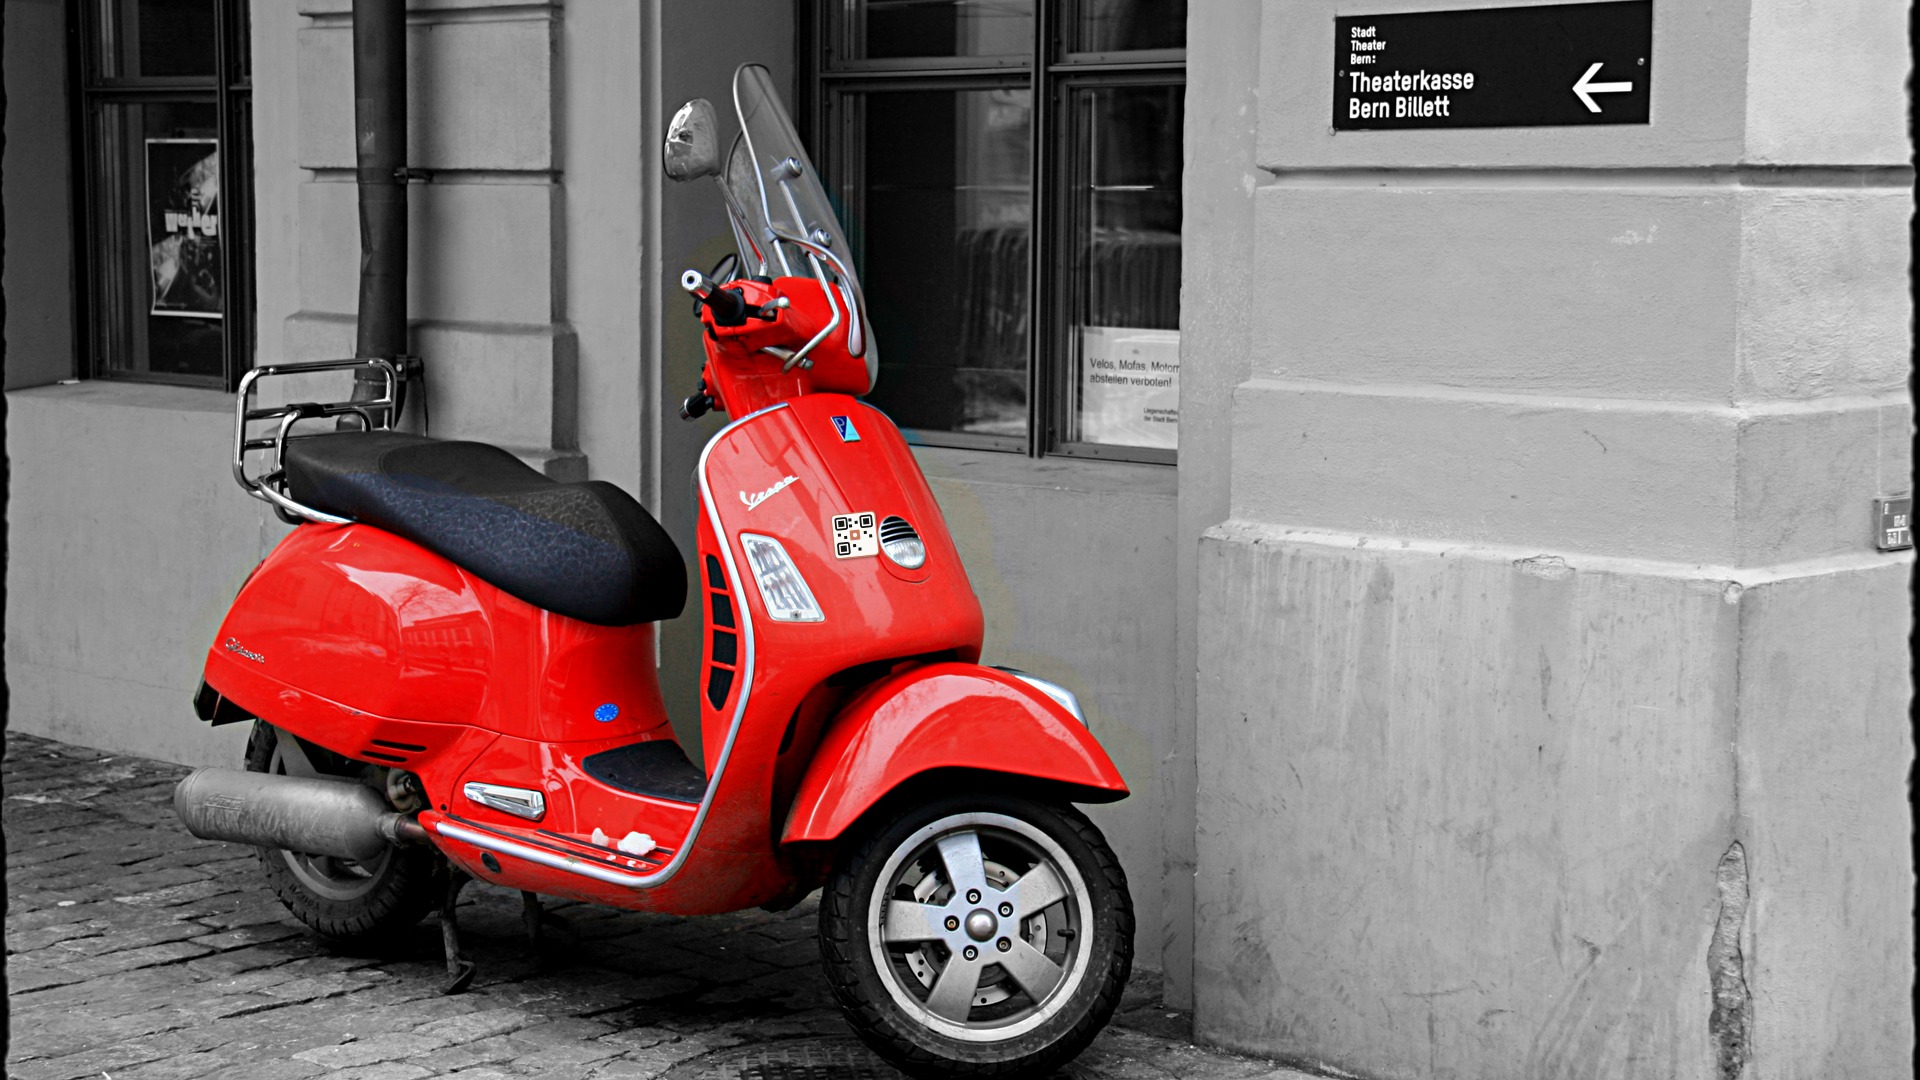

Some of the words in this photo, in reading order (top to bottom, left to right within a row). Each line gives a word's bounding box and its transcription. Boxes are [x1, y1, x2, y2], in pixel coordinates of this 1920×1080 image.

[1351, 26, 1376, 38] Stadt
[1350, 39, 1386, 51] Theater
[1349, 70, 1474, 92] Theaterkasse
[1349, 98, 1390, 119] Bern
[1395, 95, 1450, 118] Billett
[1090, 358, 1116, 371] Velos,
[1119, 360, 1148, 372] Mofas,
[1090, 374, 1128, 384] abstellen
[1130, 377, 1172, 387] verboten!
[739, 475, 800, 512] Vespa
